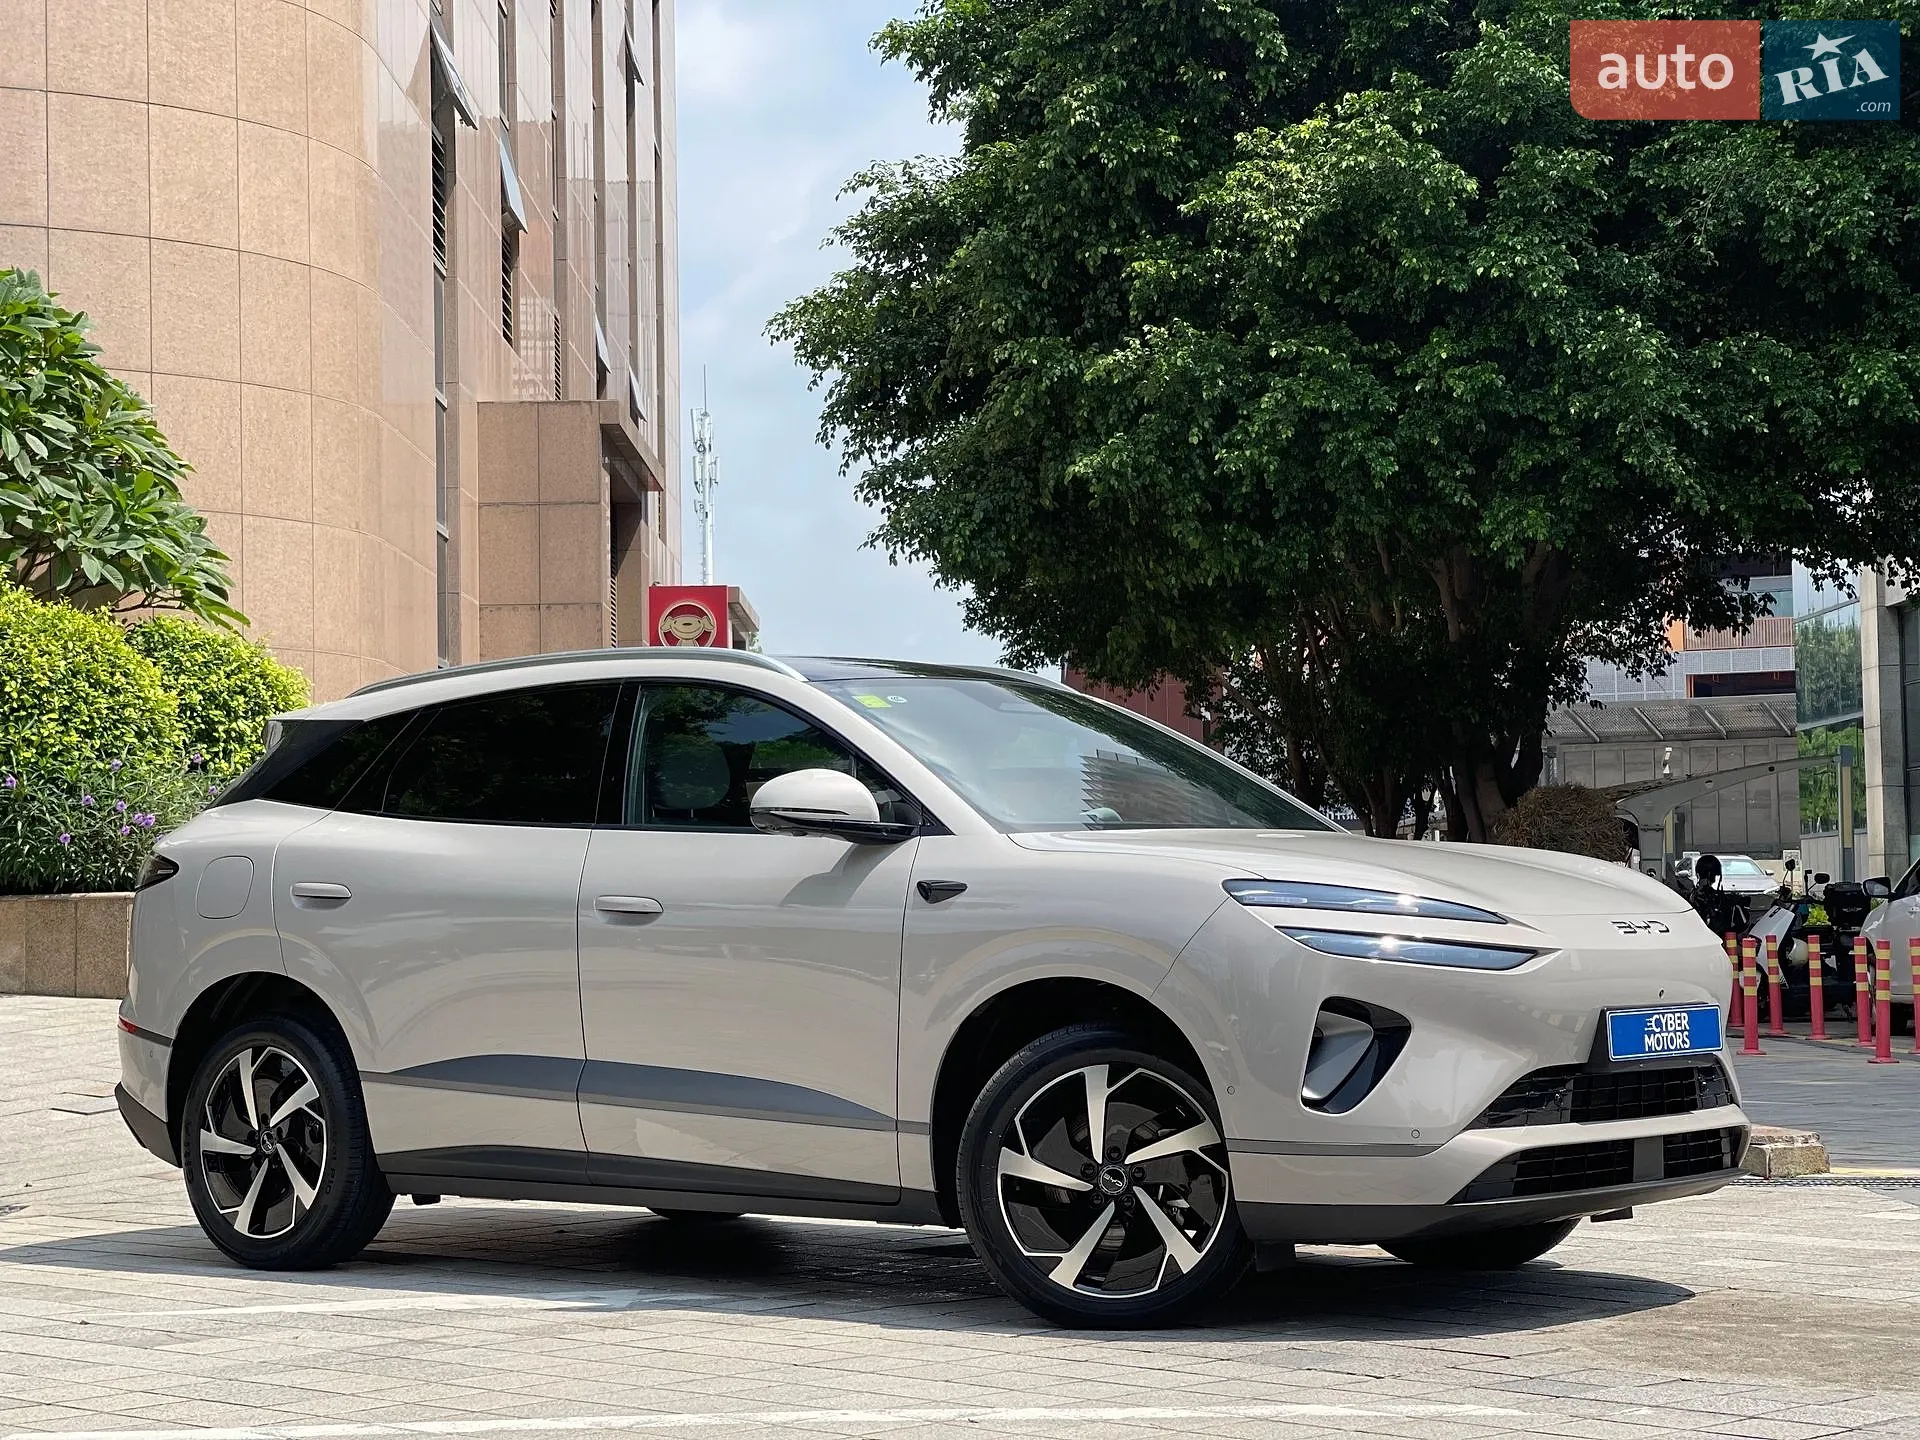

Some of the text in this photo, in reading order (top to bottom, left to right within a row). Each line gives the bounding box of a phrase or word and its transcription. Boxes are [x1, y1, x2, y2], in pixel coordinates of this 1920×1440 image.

[1611, 920, 1670, 934] BYD
[1651, 1012, 1690, 1032] CYBER
[1644, 1031, 1690, 1051] MOTORS
